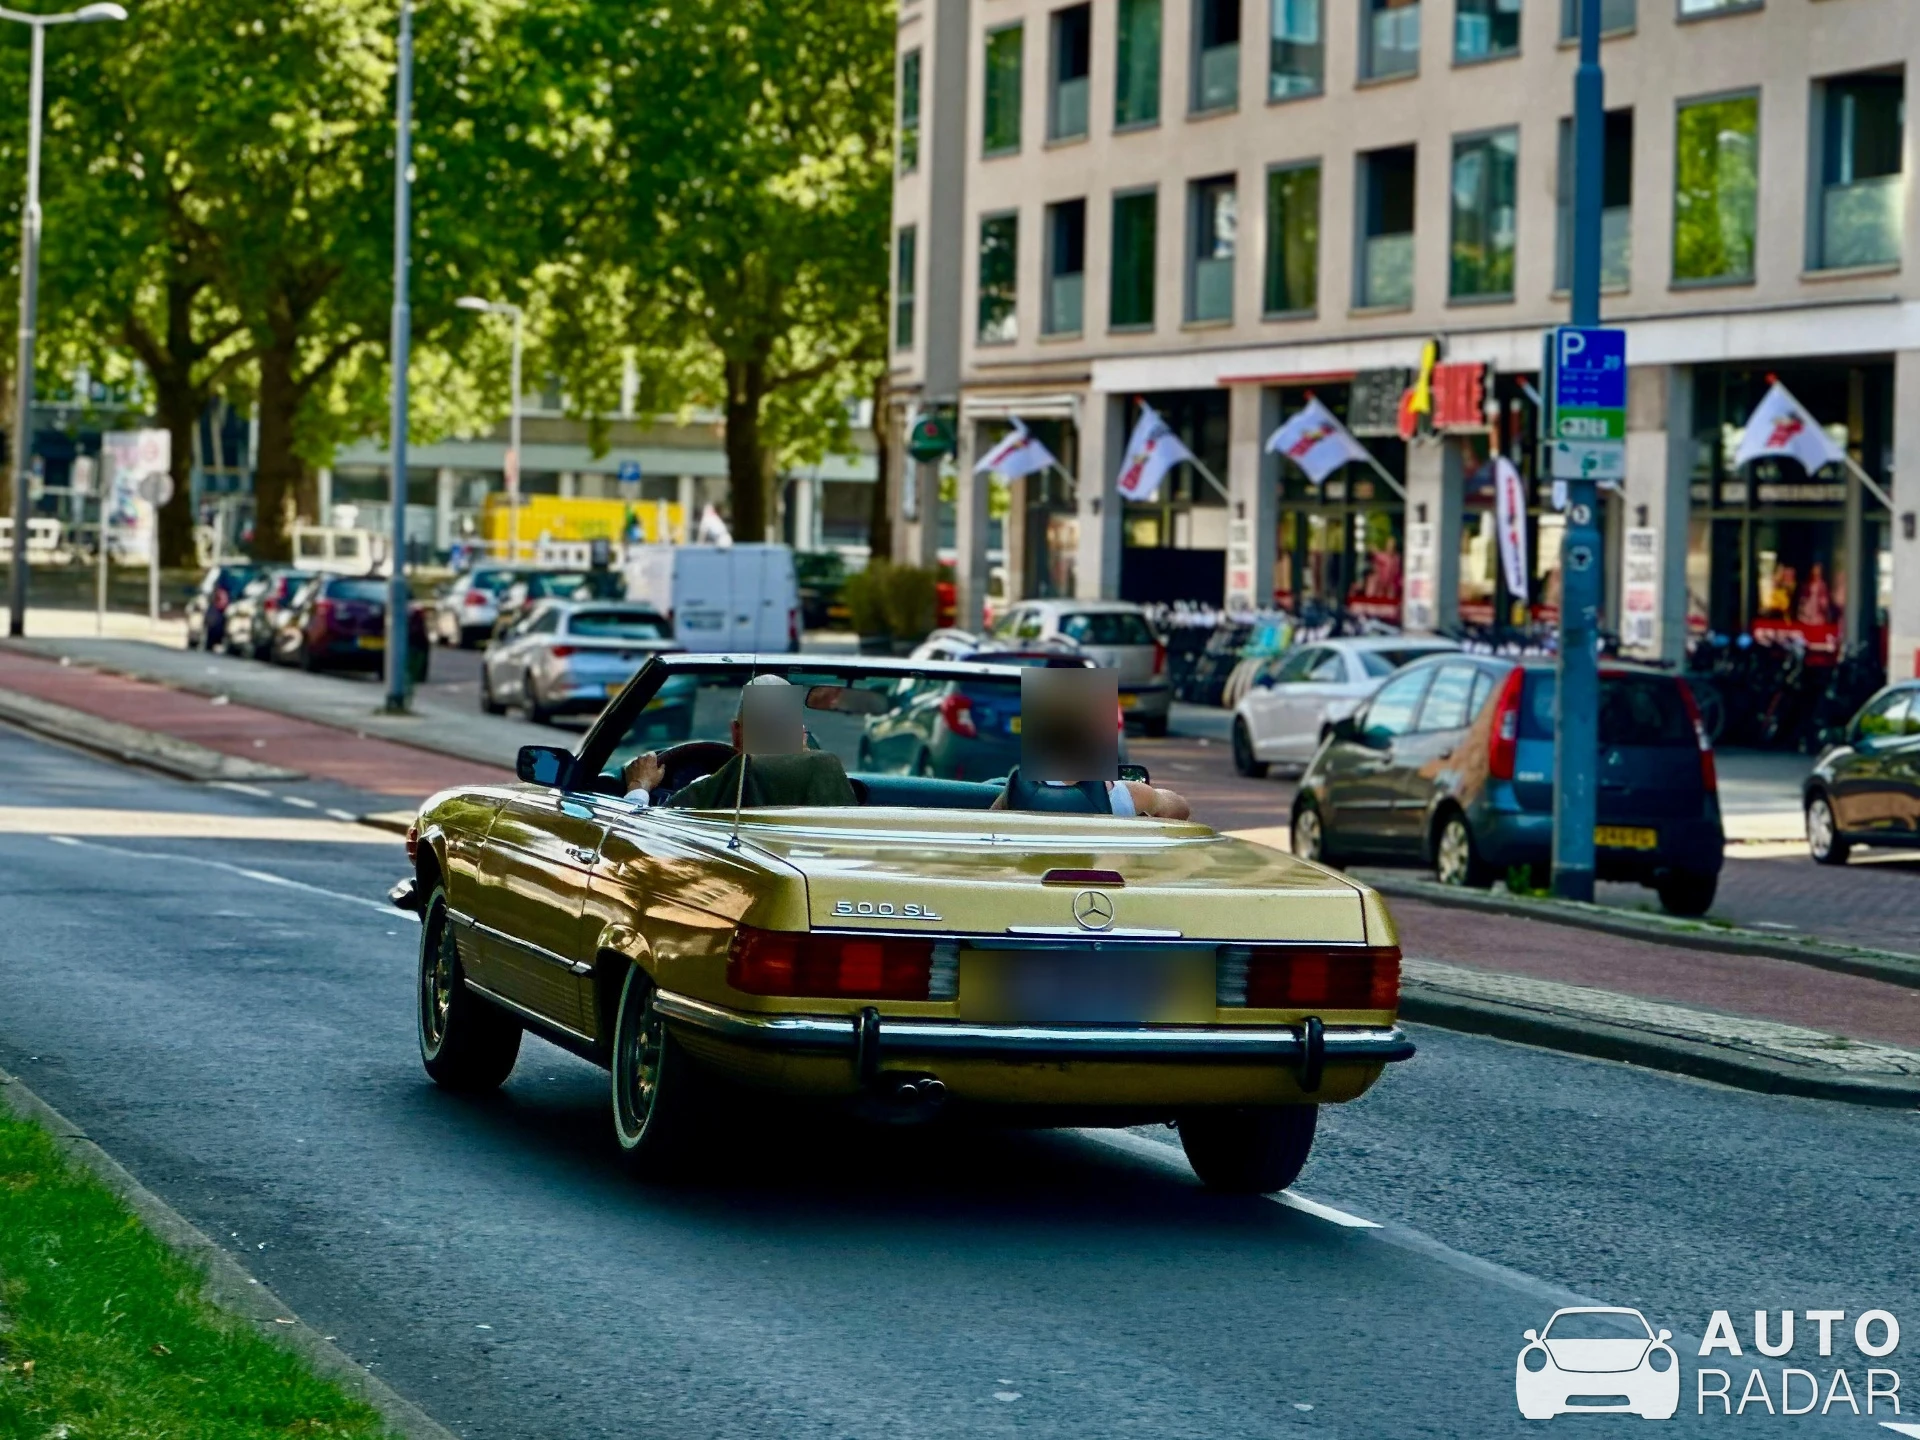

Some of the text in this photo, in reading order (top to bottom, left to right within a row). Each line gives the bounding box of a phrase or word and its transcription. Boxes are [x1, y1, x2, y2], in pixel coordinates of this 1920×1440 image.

[1561, 331, 1586, 367] P
[836, 900, 936, 916] 500 SL
